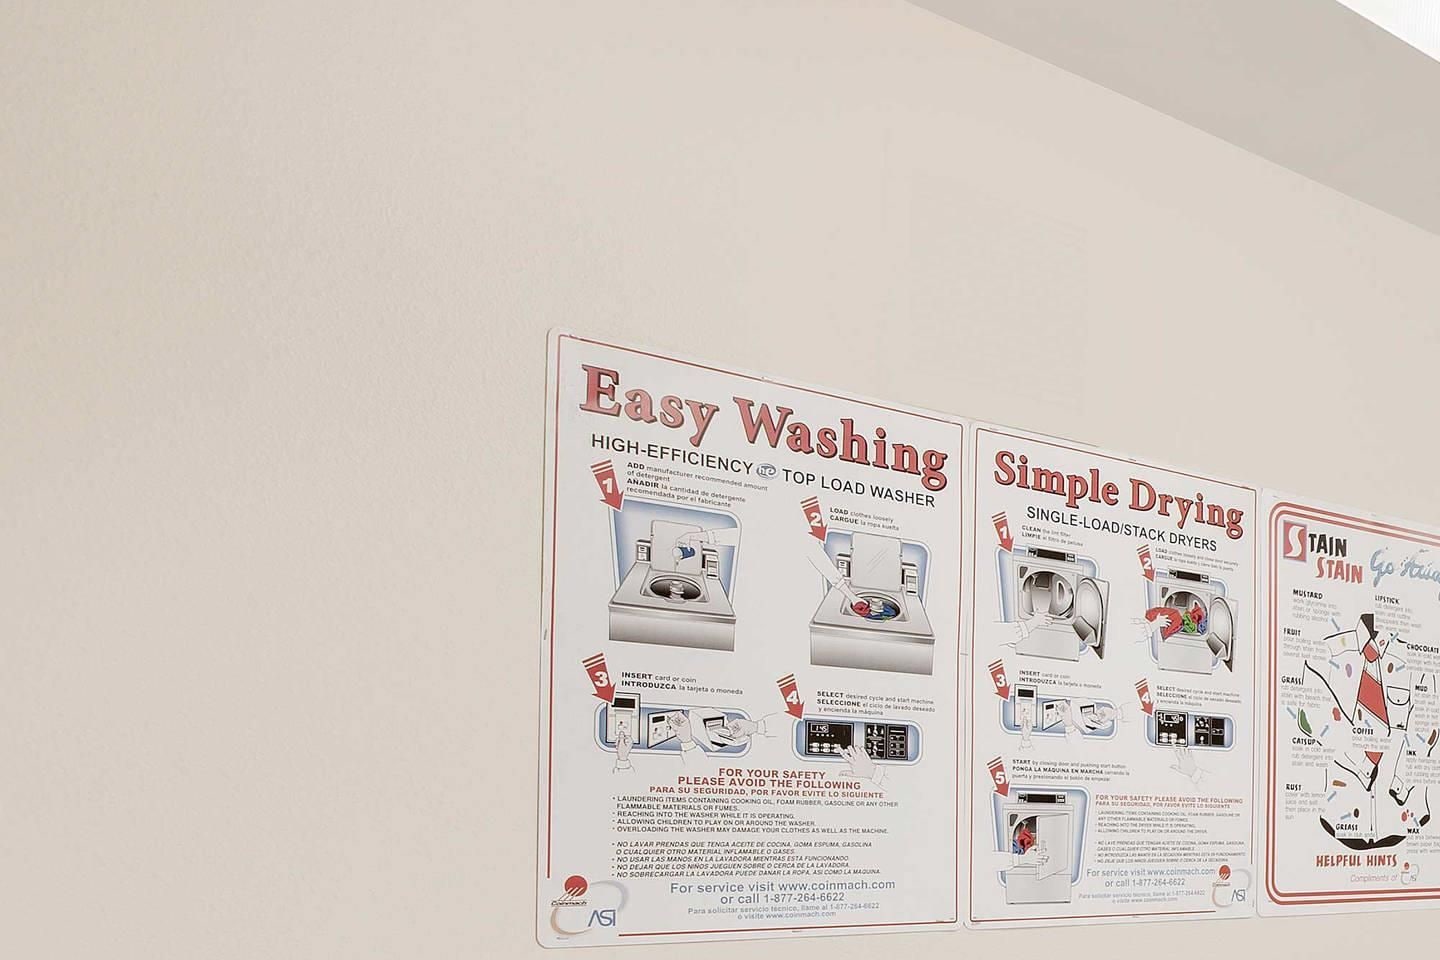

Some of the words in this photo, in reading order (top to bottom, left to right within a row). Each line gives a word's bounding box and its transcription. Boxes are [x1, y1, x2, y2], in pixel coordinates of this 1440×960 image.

[579, 364, 719, 447] Easy
[733, 396, 948, 492] Washing
[592, 434, 754, 474] HIGH-EFFICIENCY
[782, 469, 815, 485] TOP
[821, 476, 864, 495] LOAD
[871, 485, 935, 507] WASHER
[636, 471, 670, 482] detergent
[646, 466, 693, 478] manufacturer
[695, 474, 742, 487] recommended
[744, 483, 768, 491] amount
[602, 478, 612, 493] 1
[670, 485, 699, 495] cantidad
[711, 491, 746, 502] detergente
[994, 451, 1119, 509] Simple
[1129, 478, 1244, 539] Drying
[810, 512, 821, 526] 2
[830, 507, 848, 515] LOAD
[850, 511, 871, 519] clothes
[873, 514, 894, 523] loosely
[830, 515, 859, 524] CARGUE
[882, 523, 899, 531] suelta
[1027, 506, 1165, 542] SINGLE-LOAD/STACK
[1169, 533, 1217, 551] DRYERS
[1000, 526, 1007, 538] 1
[1284, 521, 1347, 559] STAIN
[1144, 558, 1151, 569] 2
[1316, 557, 1362, 583] STAIN
[1293, 589, 1323, 599] MUSTARD
[1375, 595, 1399, 604] LIPSTICK
[1284, 628, 1301, 636] FRUIT
[1407, 643, 1439, 653] CHOCOLATE
[594, 672, 607, 686] 3
[622, 672, 652, 680] INSERT
[996, 674, 1005, 687] 3
[1020, 677, 1056, 685] INTRODUZCA
[1282, 676, 1302, 685] GRASS
[622, 681, 676, 689] INTRODUZCA
[787, 691, 798, 704] 4
[817, 699, 860, 707] SELECCIONE
[1142, 692, 1149, 703] 4
[1292, 737, 1315, 745] CATSUP
[719, 768, 742, 777] FOR
[747, 769, 778, 778] YOUR
[783, 770, 826, 779] SAFETY
[995, 772, 1004, 784] 5
[678, 777, 725, 785] PLEASE
[729, 778, 765, 787] AVOID
[797, 781, 861, 789] FOLLOWING
[694, 787, 748, 795] SEGURIDAD,
[1316, 854, 1362, 867] HELPFUL
[1367, 854, 1398, 867] HINTS
[1087, 869, 1100, 877] For
[1102, 868, 1128, 876] service
[1131, 868, 1145, 876] visit
[1147, 866, 1215, 876] www.coinmach.com
[671, 883, 693, 893] For
[697, 882, 744, 892] service
[749, 882, 774, 892] visit
[778, 880, 896, 891] www.coinmach.com
[1116, 879, 1130, 887] call
[1133, 878, 1185, 887] 1-877-264-6622
[721, 896, 734, 904] or
[738, 893, 759, 904] call
[764, 893, 845, 903] 1-877-264-6622
